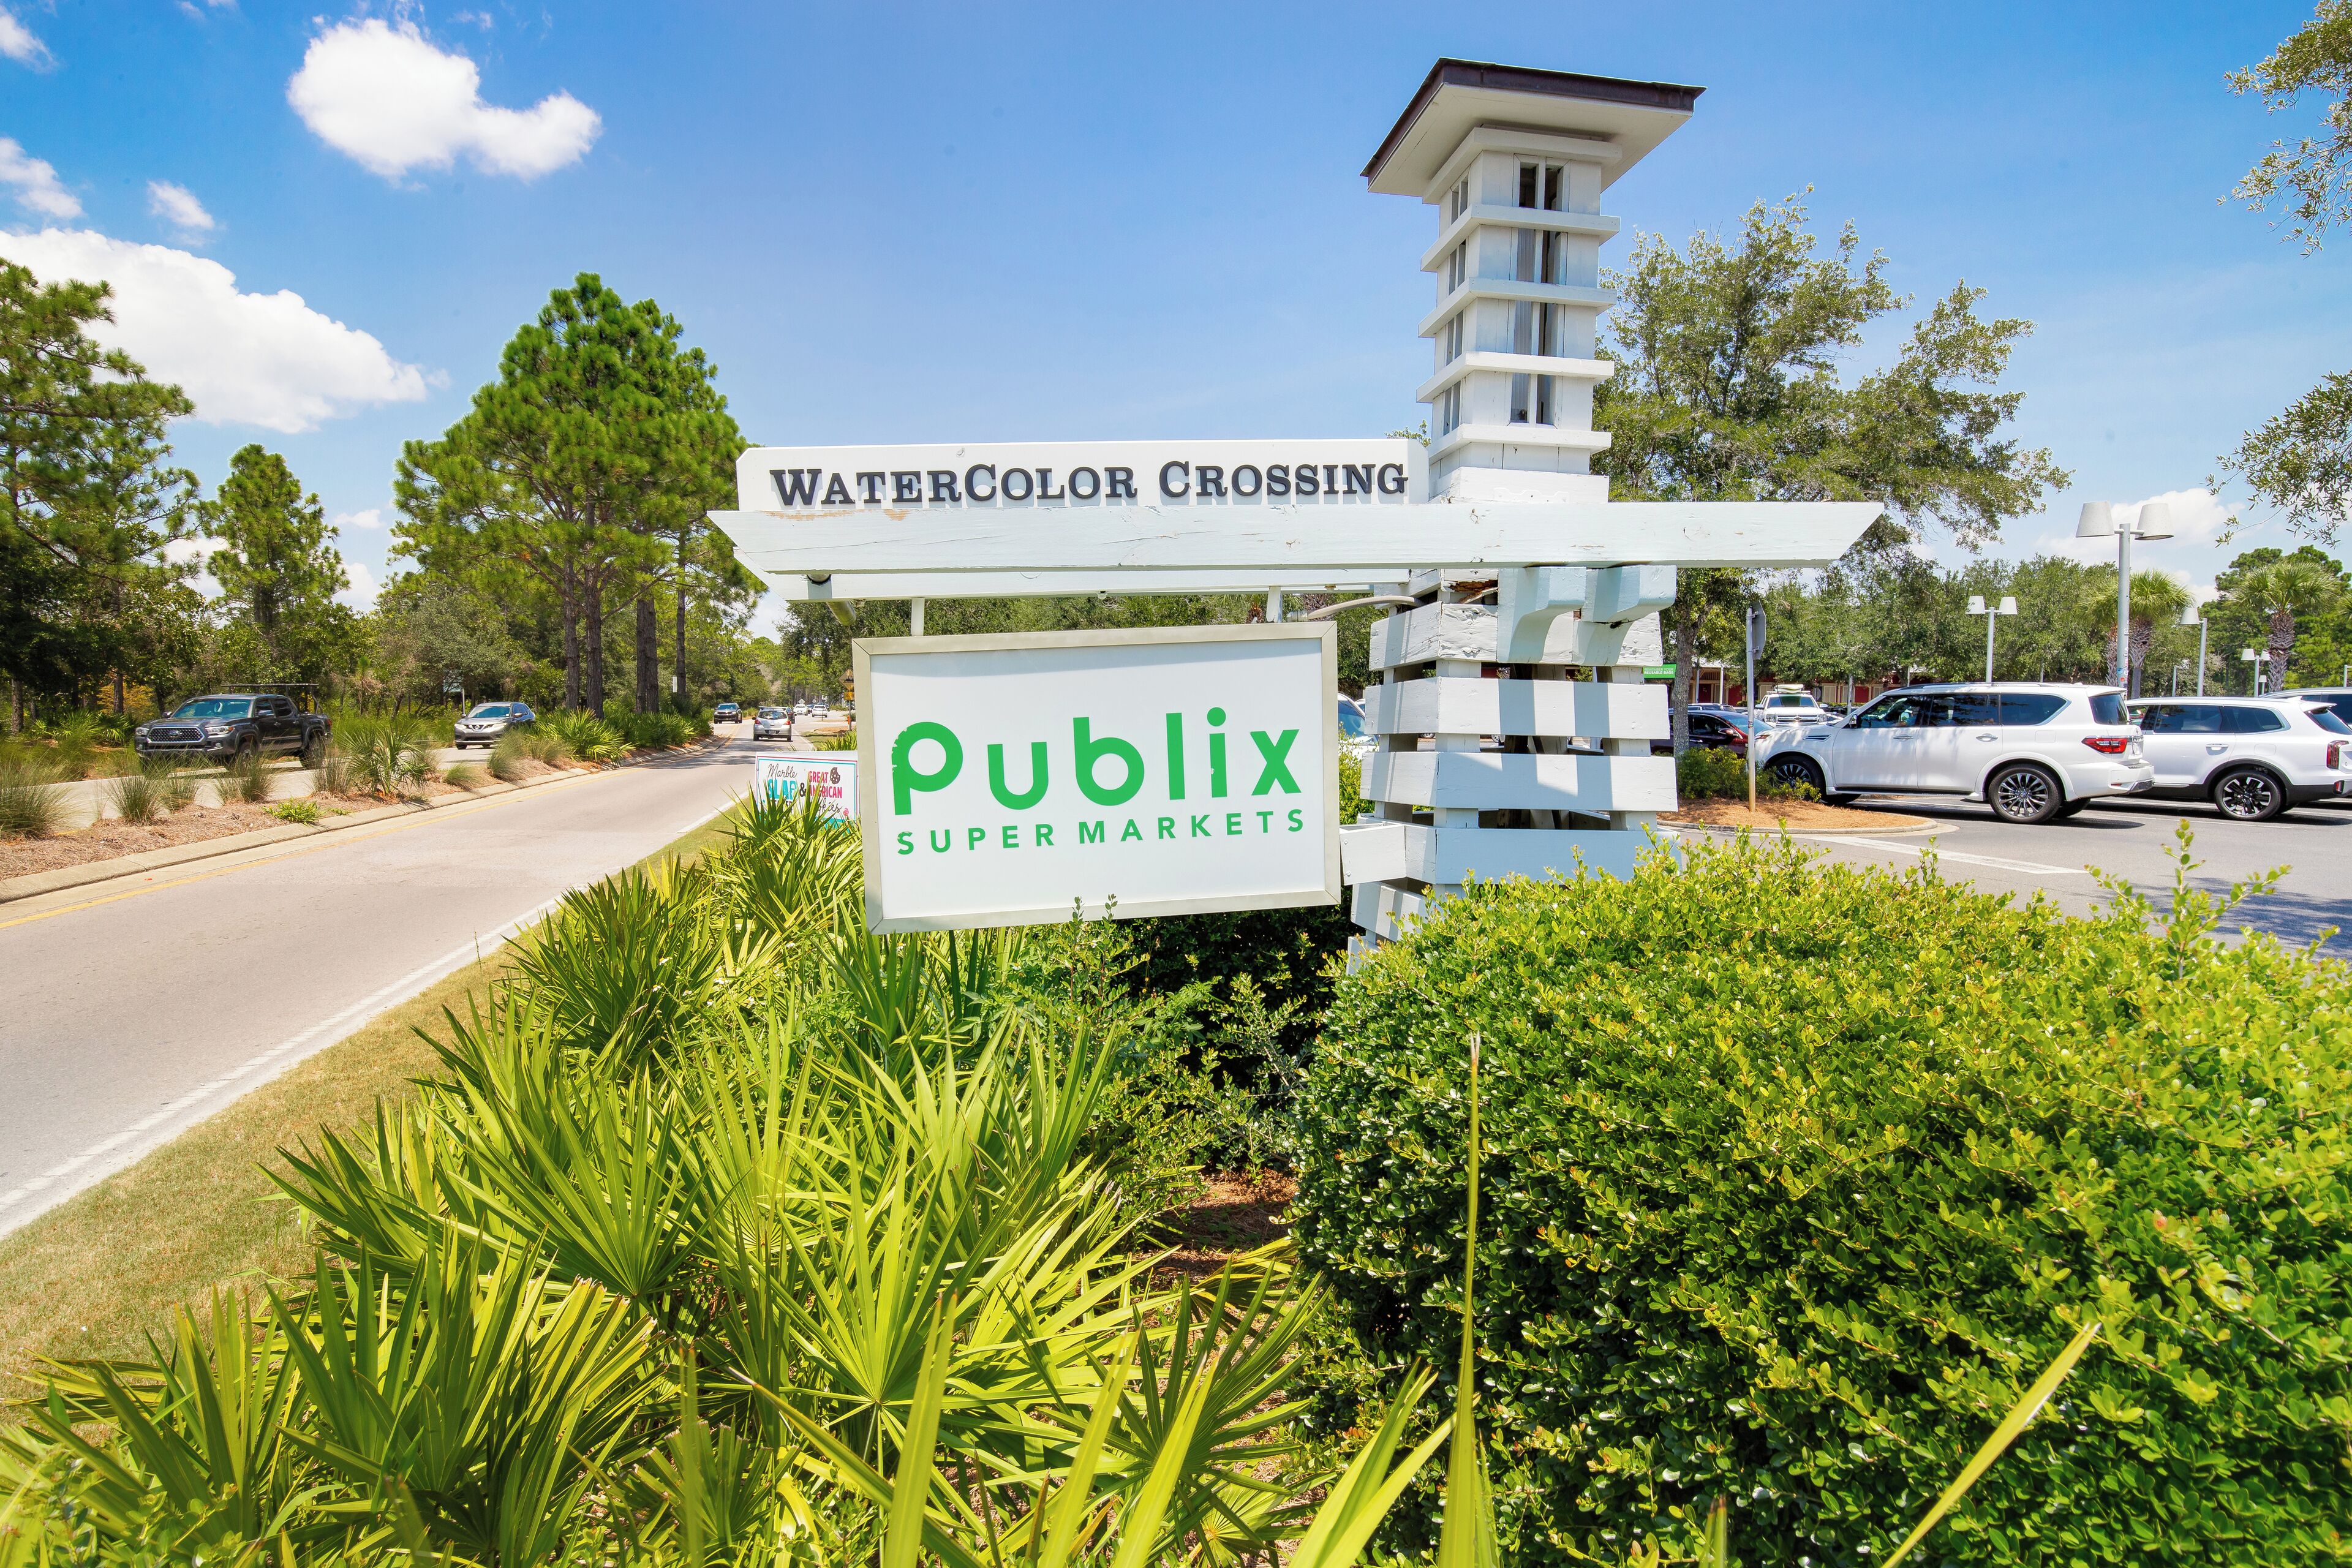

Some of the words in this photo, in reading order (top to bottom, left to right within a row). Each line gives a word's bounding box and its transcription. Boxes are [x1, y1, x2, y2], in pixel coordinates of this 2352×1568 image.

[891, 707, 1302, 815] Publix
[768, 763, 797, 779] Marble
[808, 771, 829, 783] GREAT
[799, 782, 807, 797] &
